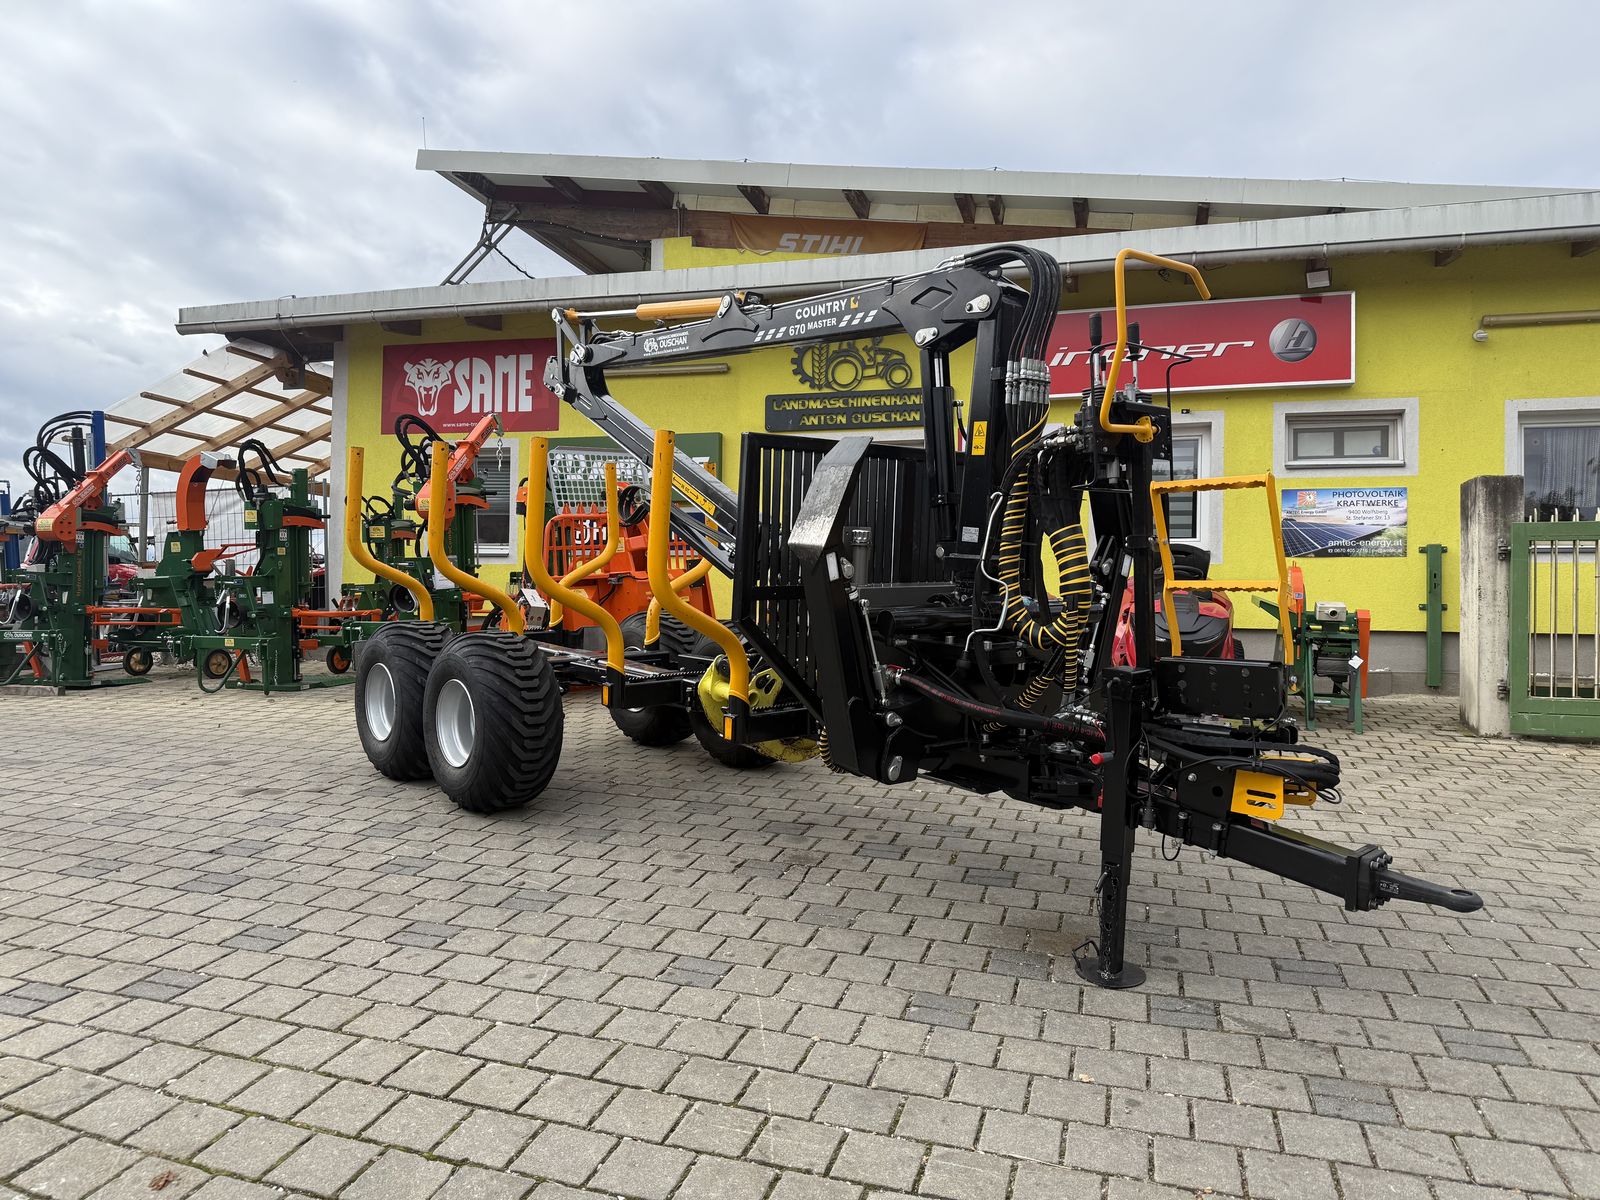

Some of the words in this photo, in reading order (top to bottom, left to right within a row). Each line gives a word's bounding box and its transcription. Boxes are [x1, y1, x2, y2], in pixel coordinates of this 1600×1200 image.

[795, 298, 848, 320] COUNTRY
[788, 325, 806, 336] 670
[807, 317, 837, 330] MASTER
[659, 335, 688, 348] OUSCHAN
[453, 353, 533, 414] SAME
[773, 394, 923, 411] LANDMASCHINENHAN
[799, 414, 847, 426] ANTON
[851, 411, 921, 424] OUSCHAN
[1332, 490, 1404, 498] PHOTOVOLTAIK
[1336, 499, 1399, 507] KRAFTWERKE
[1328, 539, 1402, 548] amtec-energy.at
